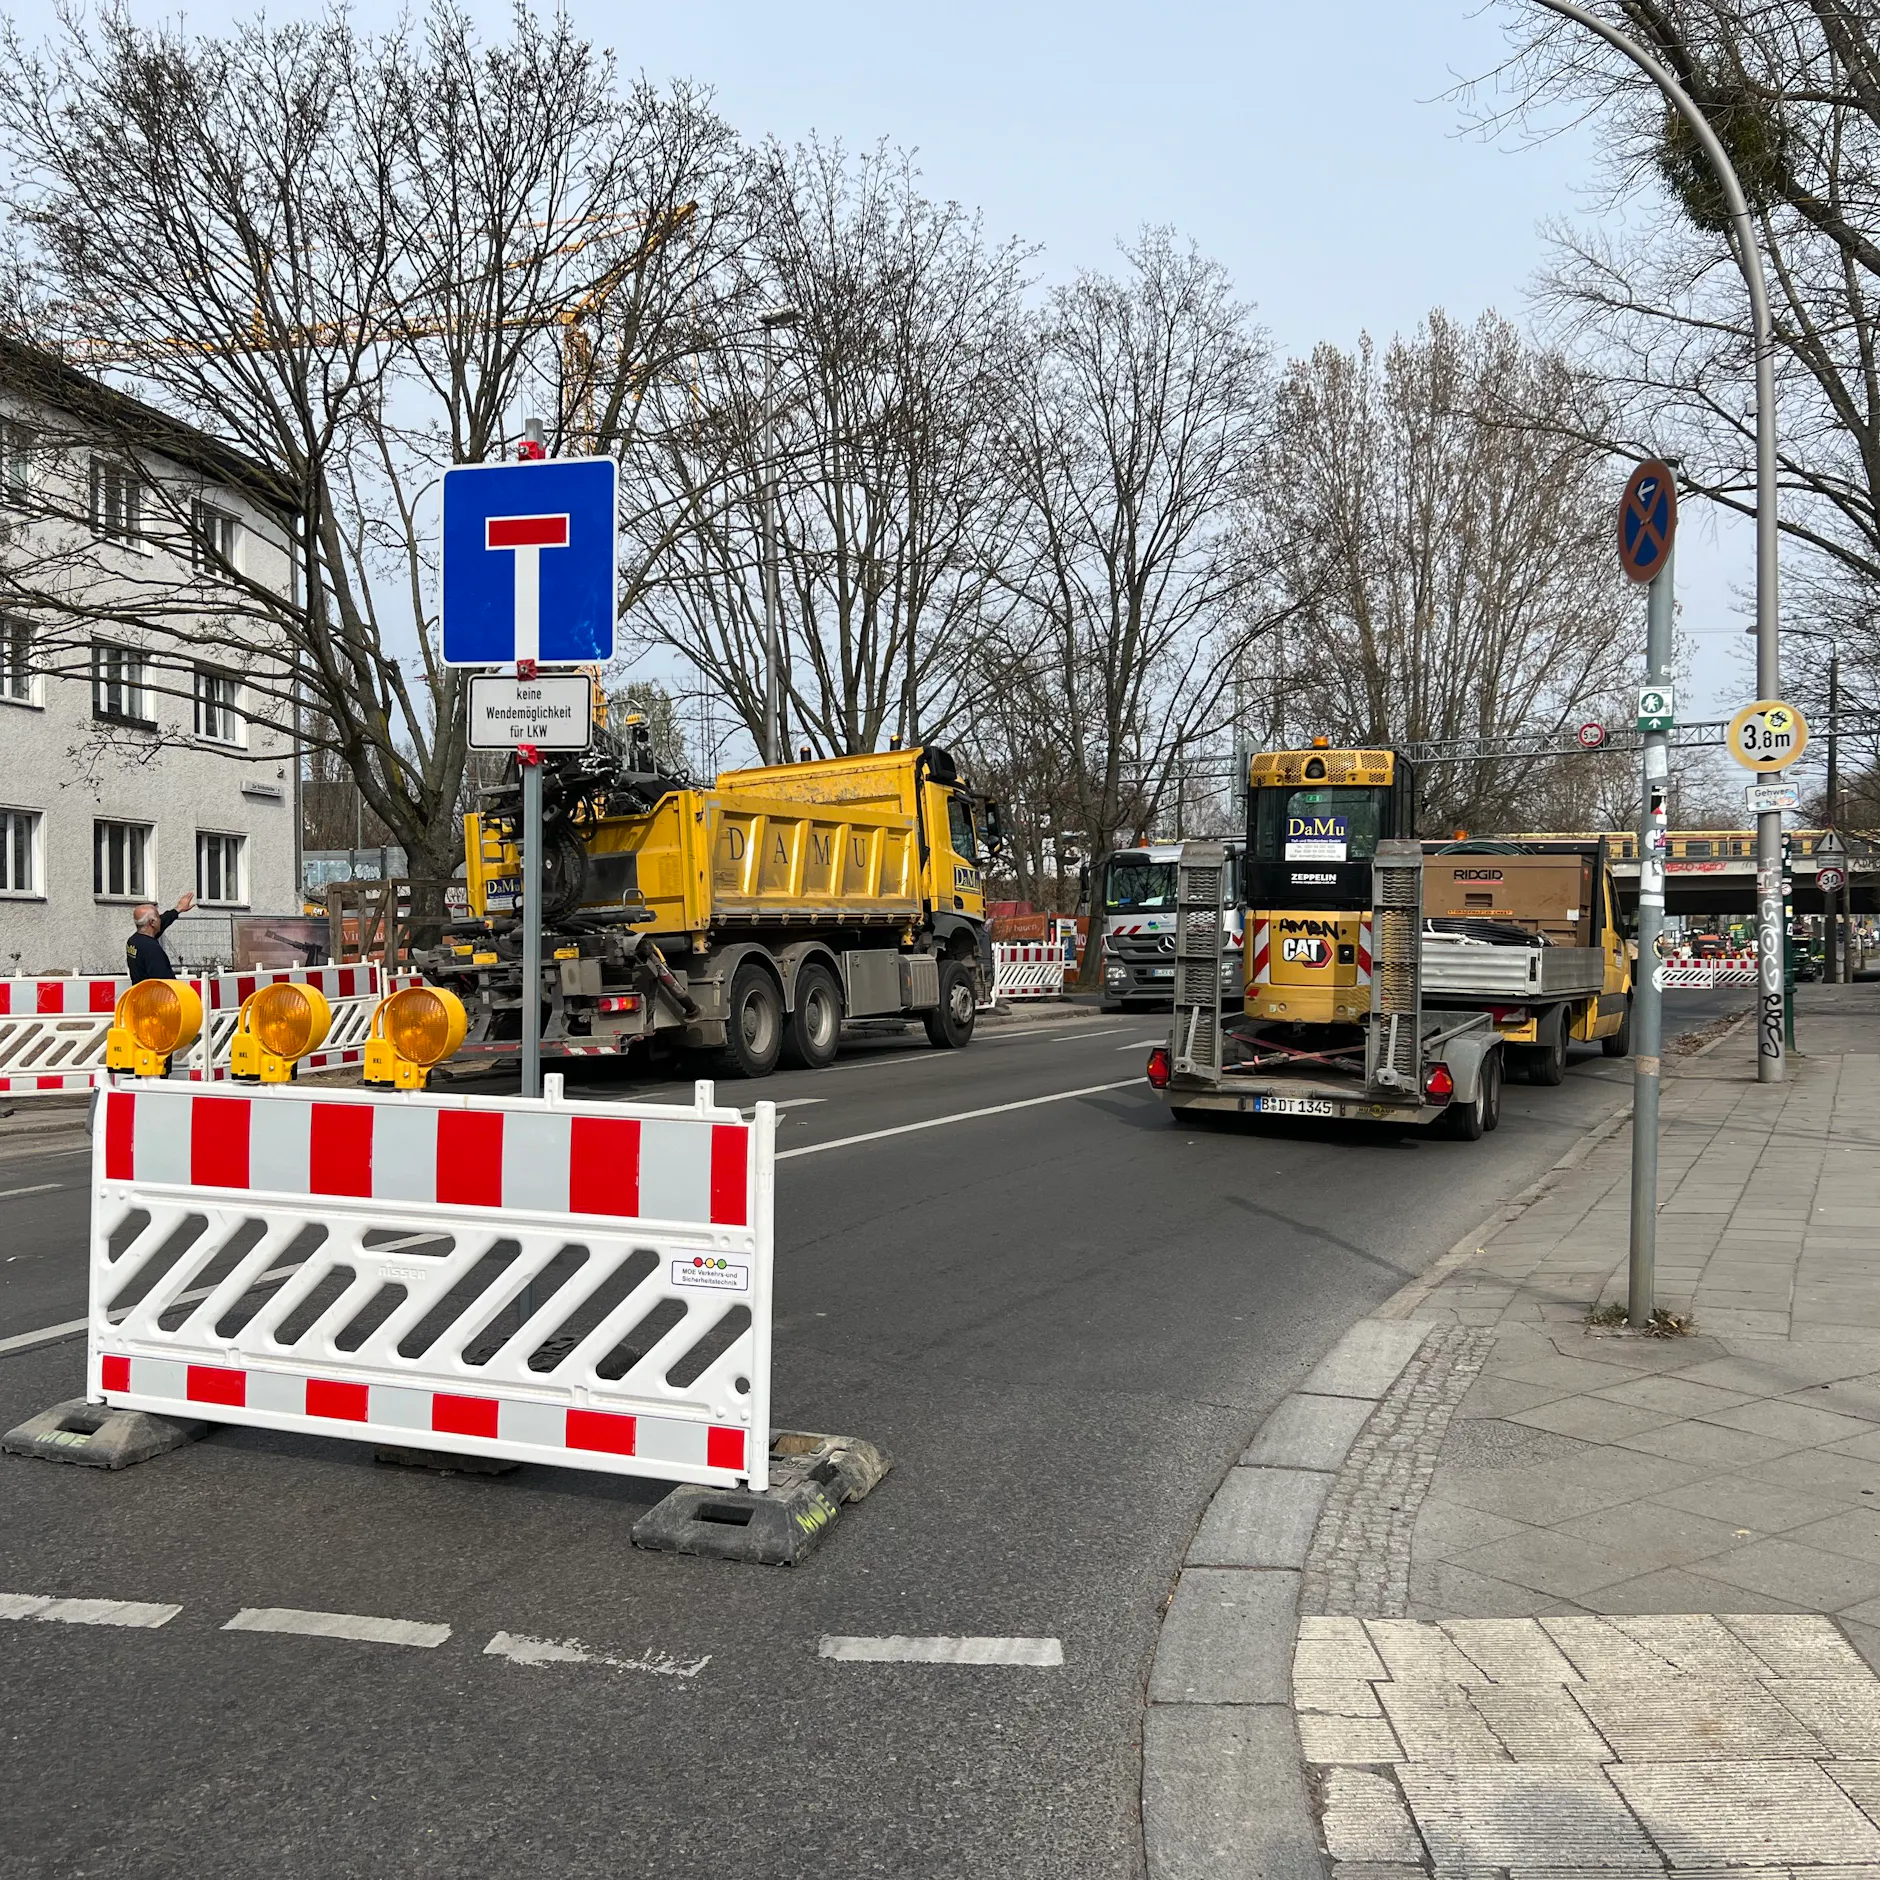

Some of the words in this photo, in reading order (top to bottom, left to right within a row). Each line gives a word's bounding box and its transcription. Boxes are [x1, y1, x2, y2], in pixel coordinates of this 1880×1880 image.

[516, 687, 542, 700] keine
[486, 705, 572, 722] Wendemöglichkeit
[510, 725, 524, 738] für
[527, 725, 548, 738] LKW
[1287, 818, 1345, 837] DaMu
[1291, 873, 1337, 882] ZEPPELIN
[1454, 869, 1504, 880] RIDGID
[1822, 874, 1839, 886] 30
[1283, 939, 1321, 962] CAT
[1261, 1099, 1270, 1111] B
[1278, 1100, 1296, 1112] DT
[1298, 1101, 1332, 1114] 1345
[378, 1260, 427, 1280] nissen
[682, 1276, 737, 1286] Sicherheitstechnik
[34, 1431, 91, 1448] MOE
[795, 1492, 837, 1534] MOE
